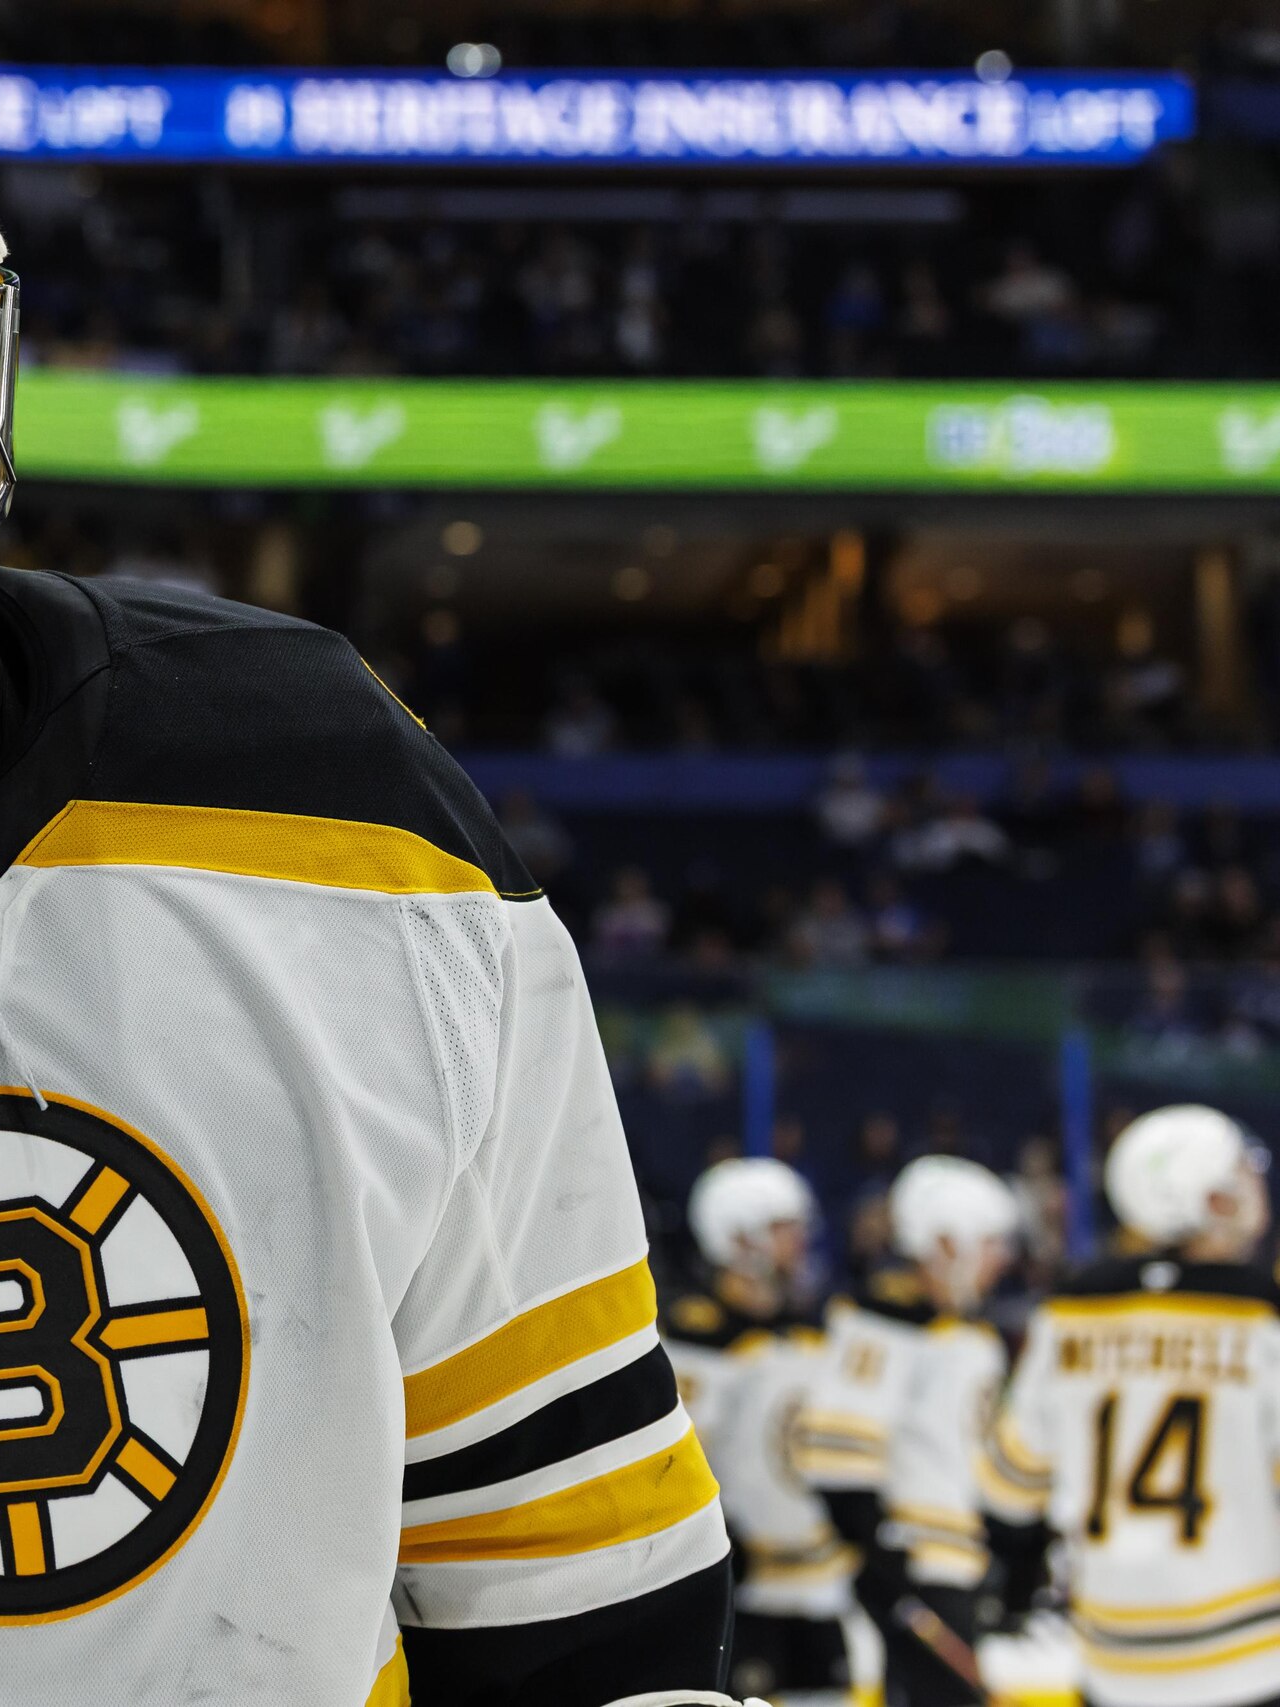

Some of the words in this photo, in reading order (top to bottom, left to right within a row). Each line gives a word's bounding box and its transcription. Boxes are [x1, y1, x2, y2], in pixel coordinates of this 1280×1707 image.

[292, 79, 631, 156] HERITAGE
[633, 80, 1029, 157] INSURANCE
[1084, 1389, 1211, 1550] 14
